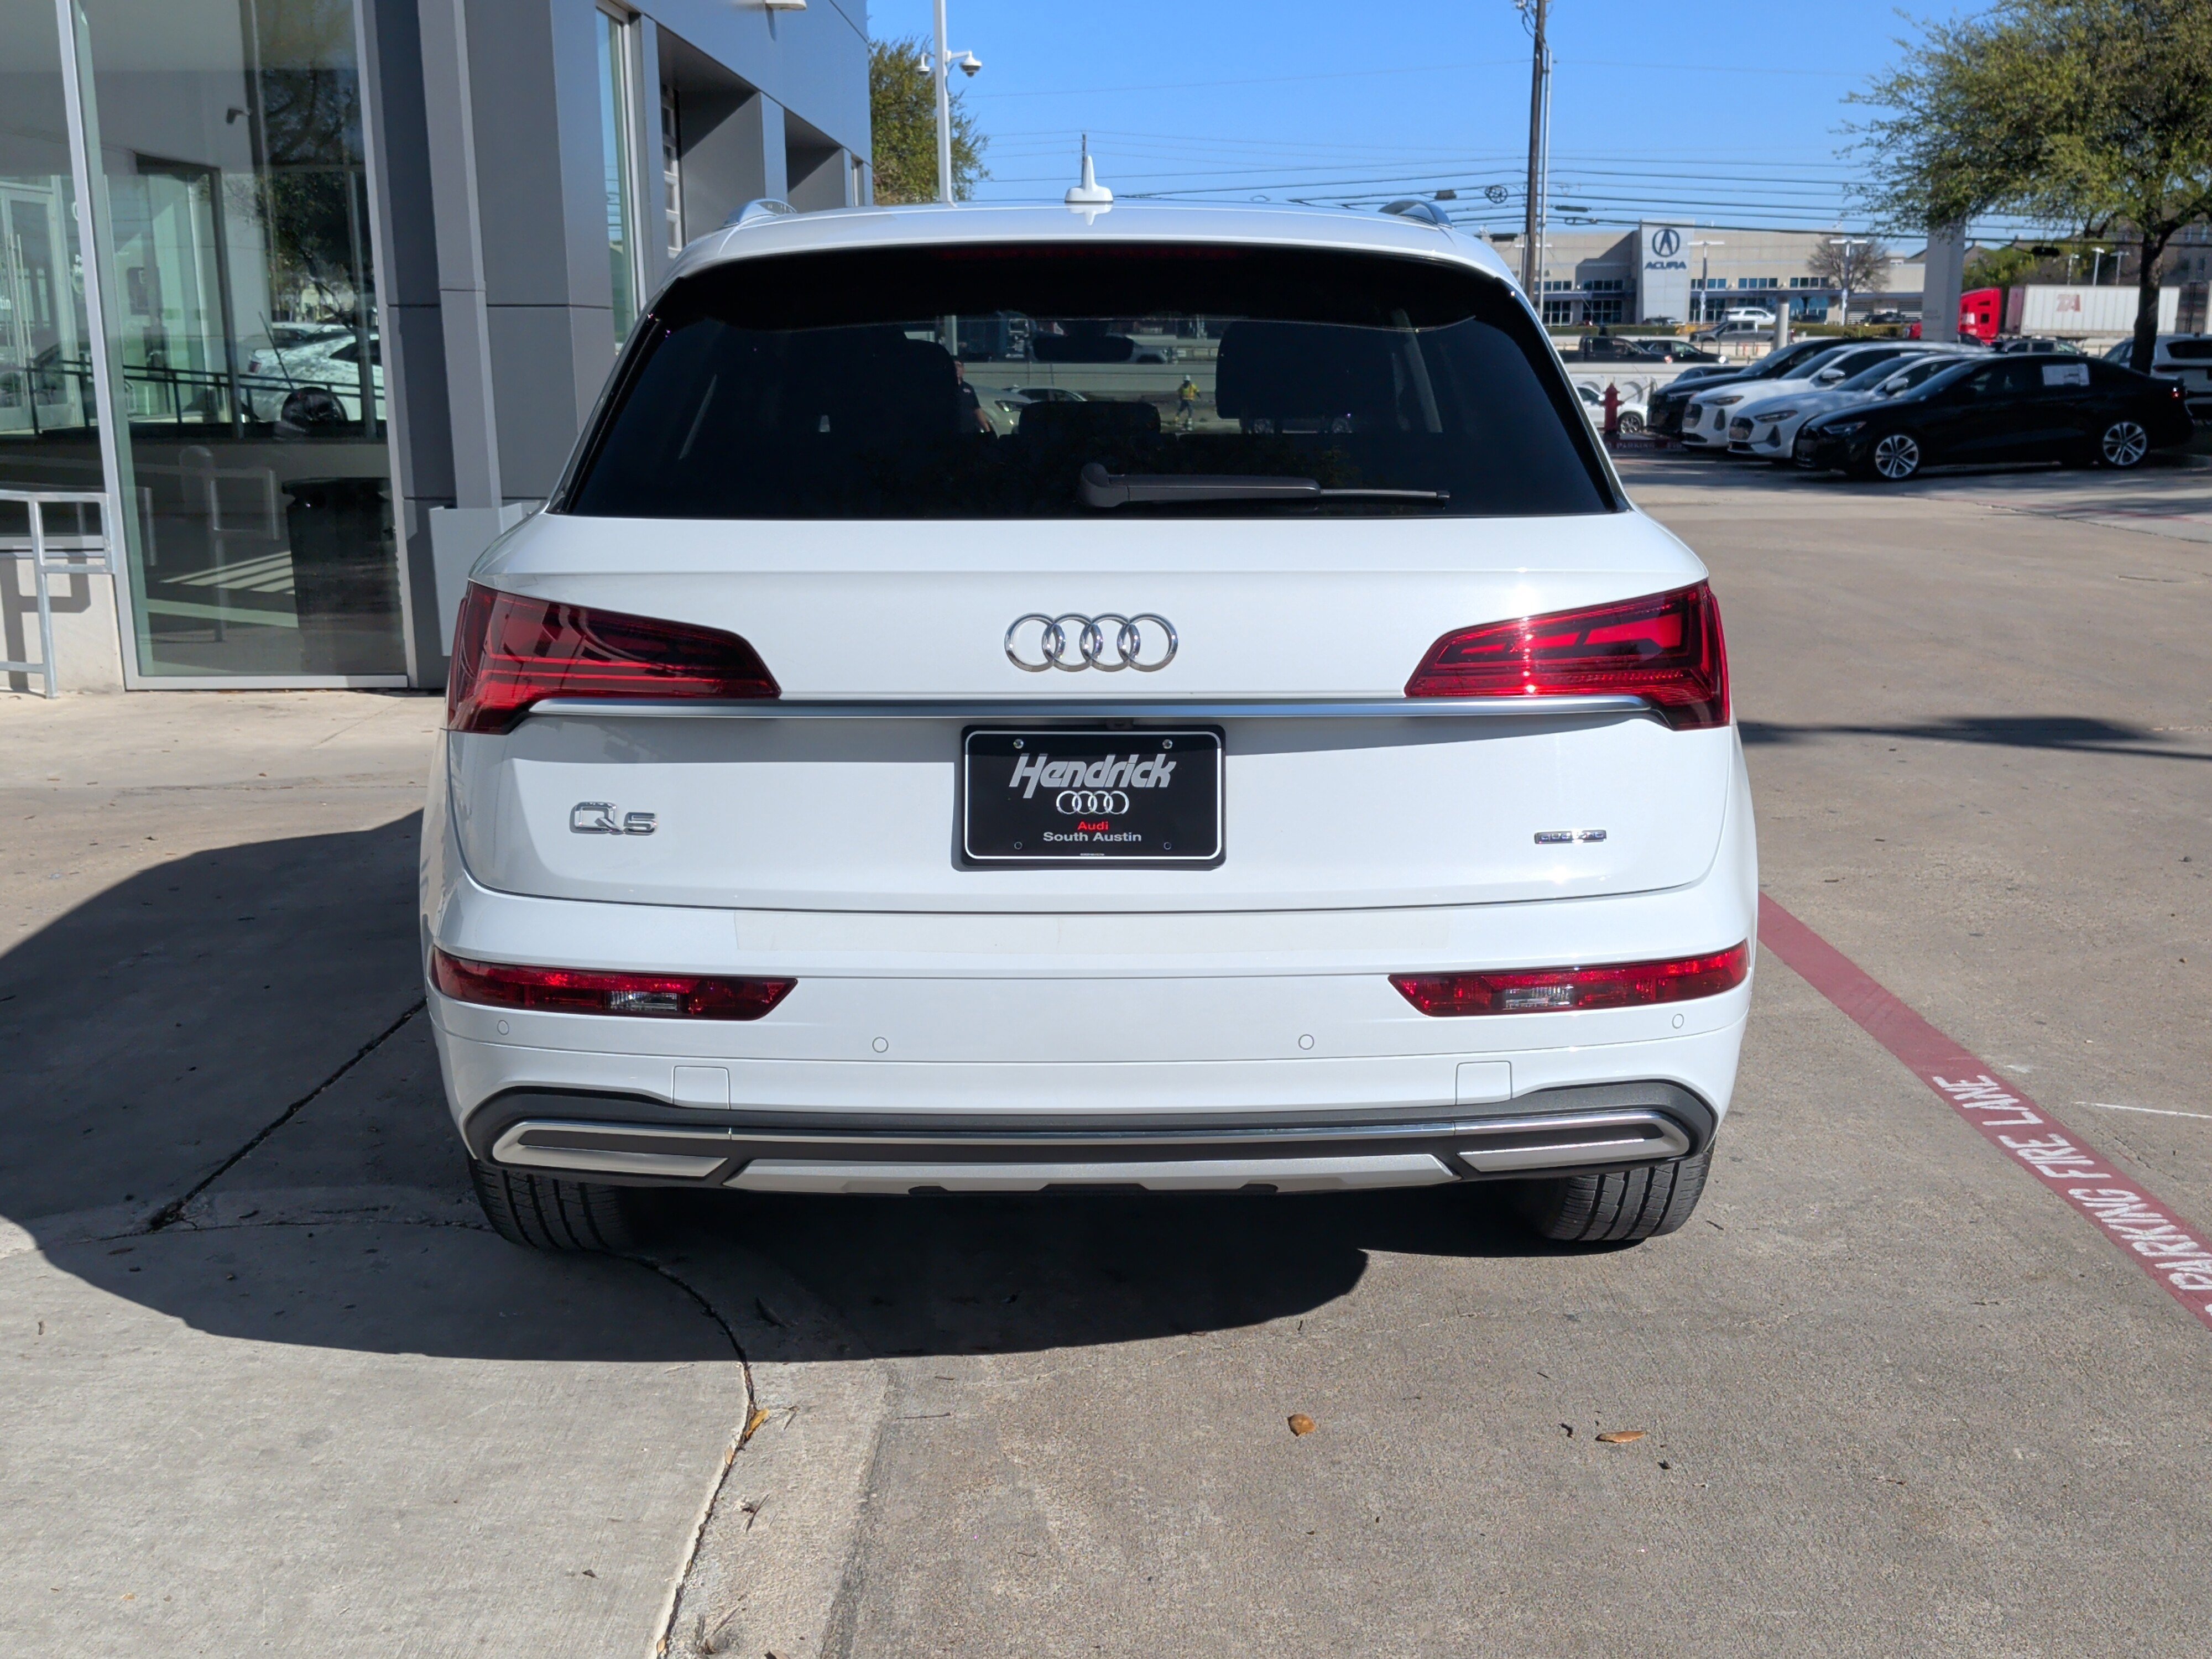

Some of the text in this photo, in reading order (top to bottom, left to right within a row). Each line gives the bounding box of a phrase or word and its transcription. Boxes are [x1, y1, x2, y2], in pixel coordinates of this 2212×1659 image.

[1645, 261, 1687, 270] ACURA
[1008, 752, 1177, 799] Hendrick
[569, 801, 659, 836] Q5
[1077, 821, 1109, 831] Audi
[1043, 832, 1142, 842] South Austin
[1932, 1074, 2212, 1290] PARKING FIRE LANE
